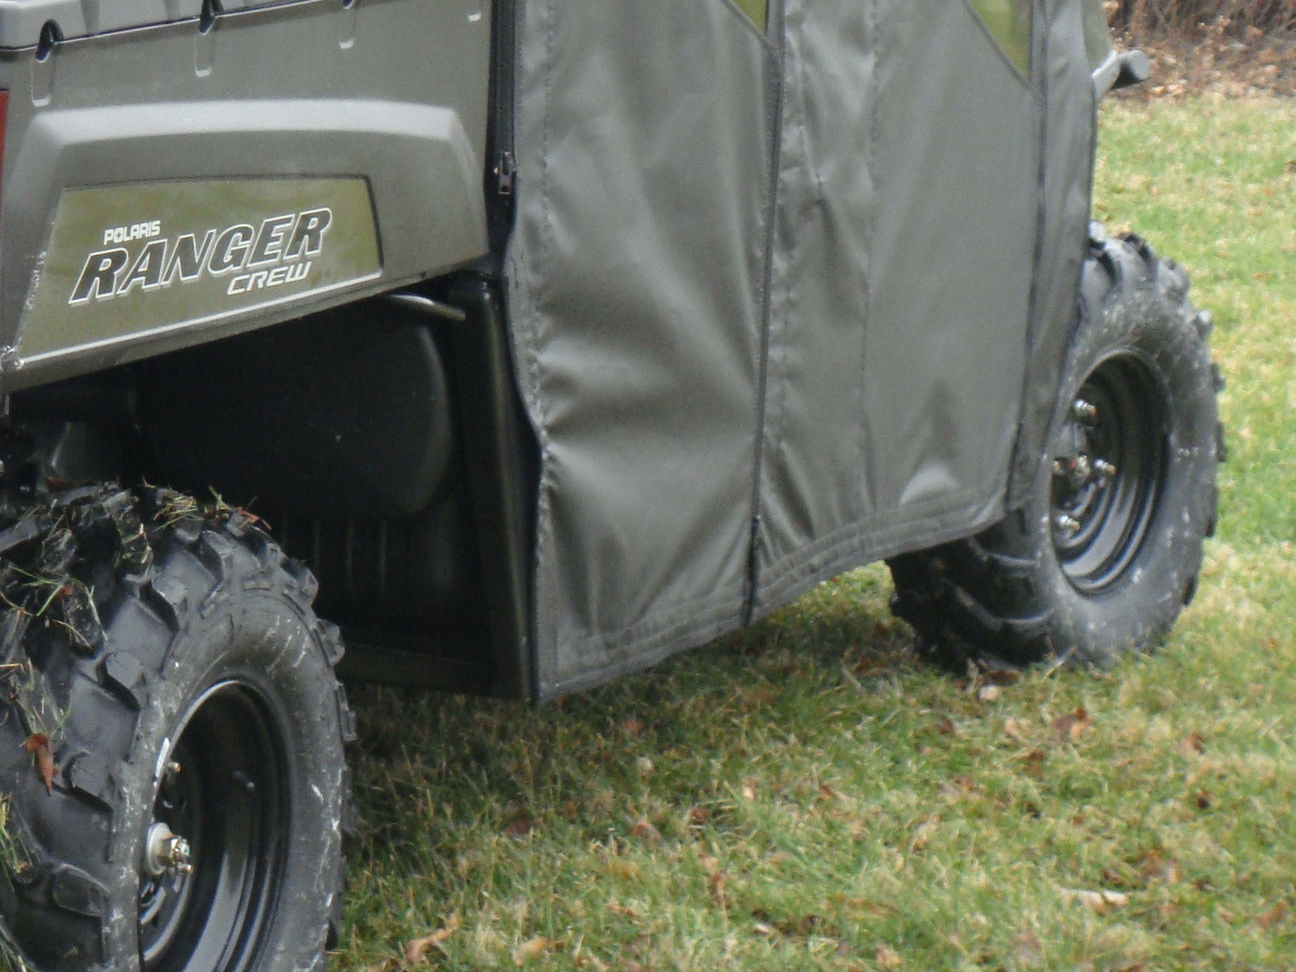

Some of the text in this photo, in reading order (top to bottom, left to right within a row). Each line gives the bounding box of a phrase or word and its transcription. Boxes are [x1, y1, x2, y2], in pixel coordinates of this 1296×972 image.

[104, 220, 161, 245] POLARIS
[68, 208, 333, 306] RANGER
[227, 262, 312, 295] CREW
